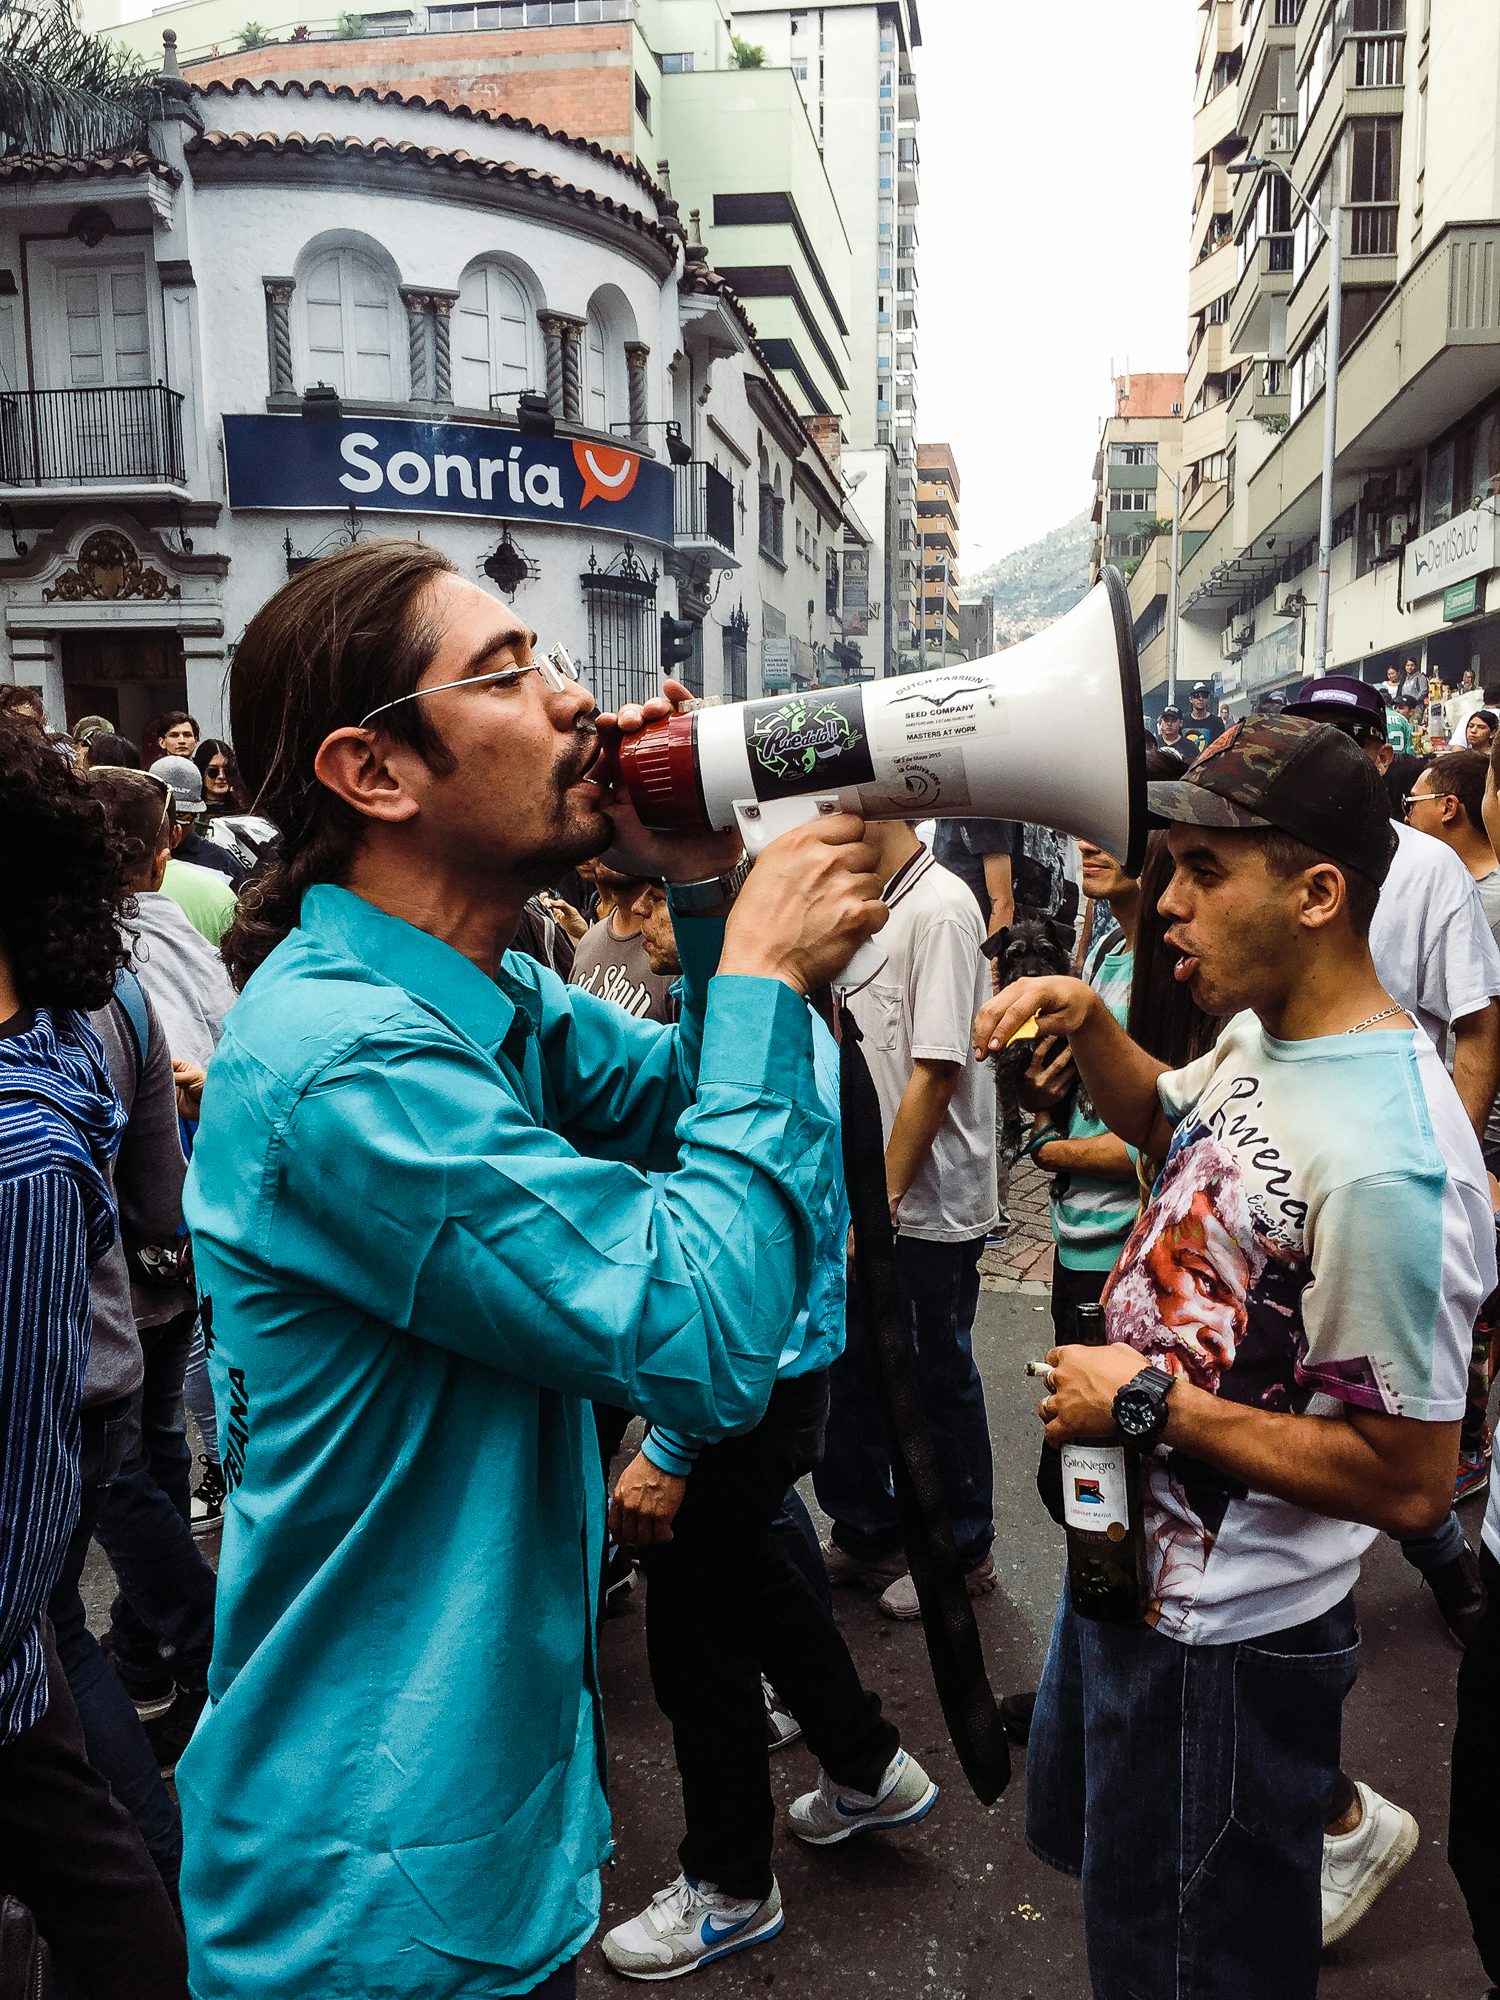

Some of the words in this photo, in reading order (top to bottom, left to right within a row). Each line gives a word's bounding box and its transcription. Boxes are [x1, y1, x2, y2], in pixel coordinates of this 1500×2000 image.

[339, 432, 564, 509] Sonría
[896, 679, 932, 695] DUTCH
[1314, 690, 1354, 701] Supreme
[905, 711, 927, 719] SEED
[930, 704, 974, 716] COMPANY
[906, 730, 941, 741] MASTERS
[943, 728, 952, 736] AT
[954, 725, 977, 734] WORK
[1209, 1076, 1309, 1230] Rivera
